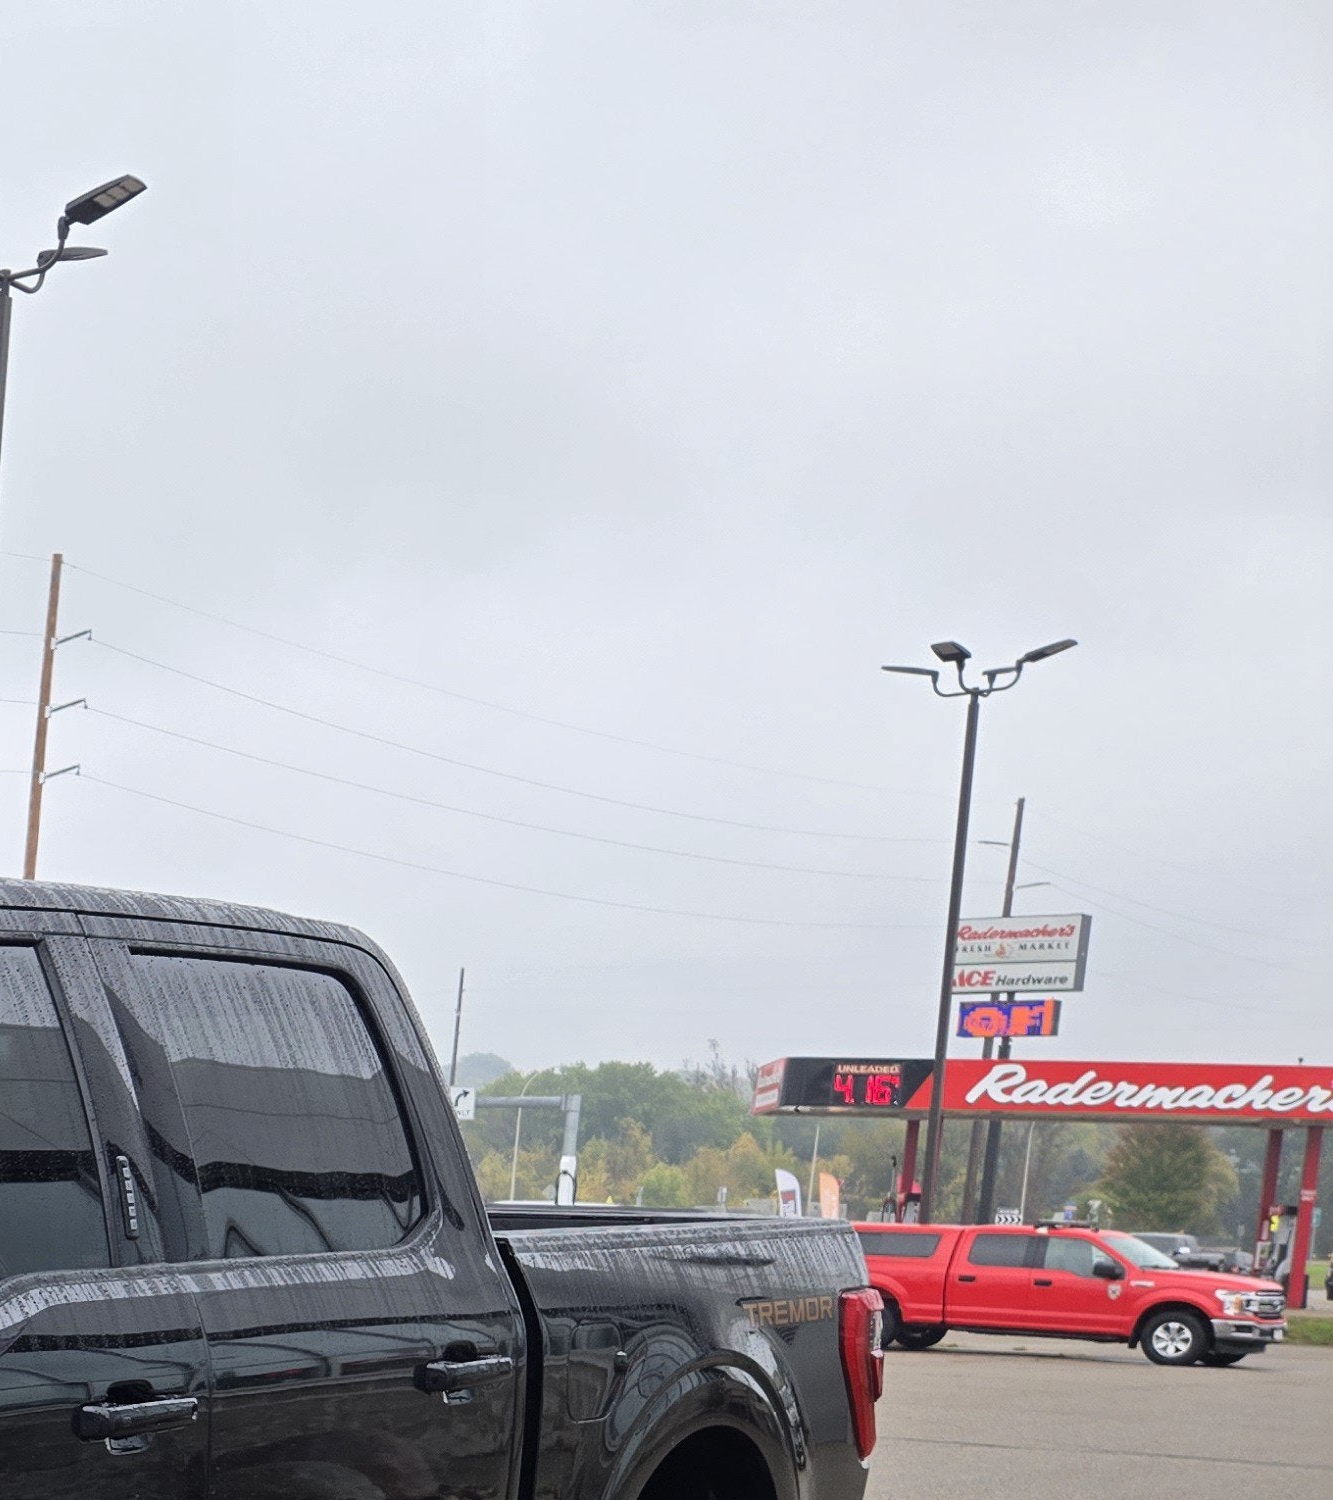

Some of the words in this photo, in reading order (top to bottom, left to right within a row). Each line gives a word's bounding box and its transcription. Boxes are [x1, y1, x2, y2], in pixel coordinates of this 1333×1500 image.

[957, 924, 1076, 941] Radermacher's
[1018, 942, 1070, 952] MARKET
[951, 969, 996, 987] ACE
[995, 974, 1069, 987] Hardware
[835, 1064, 901, 1074] UNLEADED
[964, 1063, 1333, 1113] Radermacher
[742, 1295, 833, 1330] TREMOR
